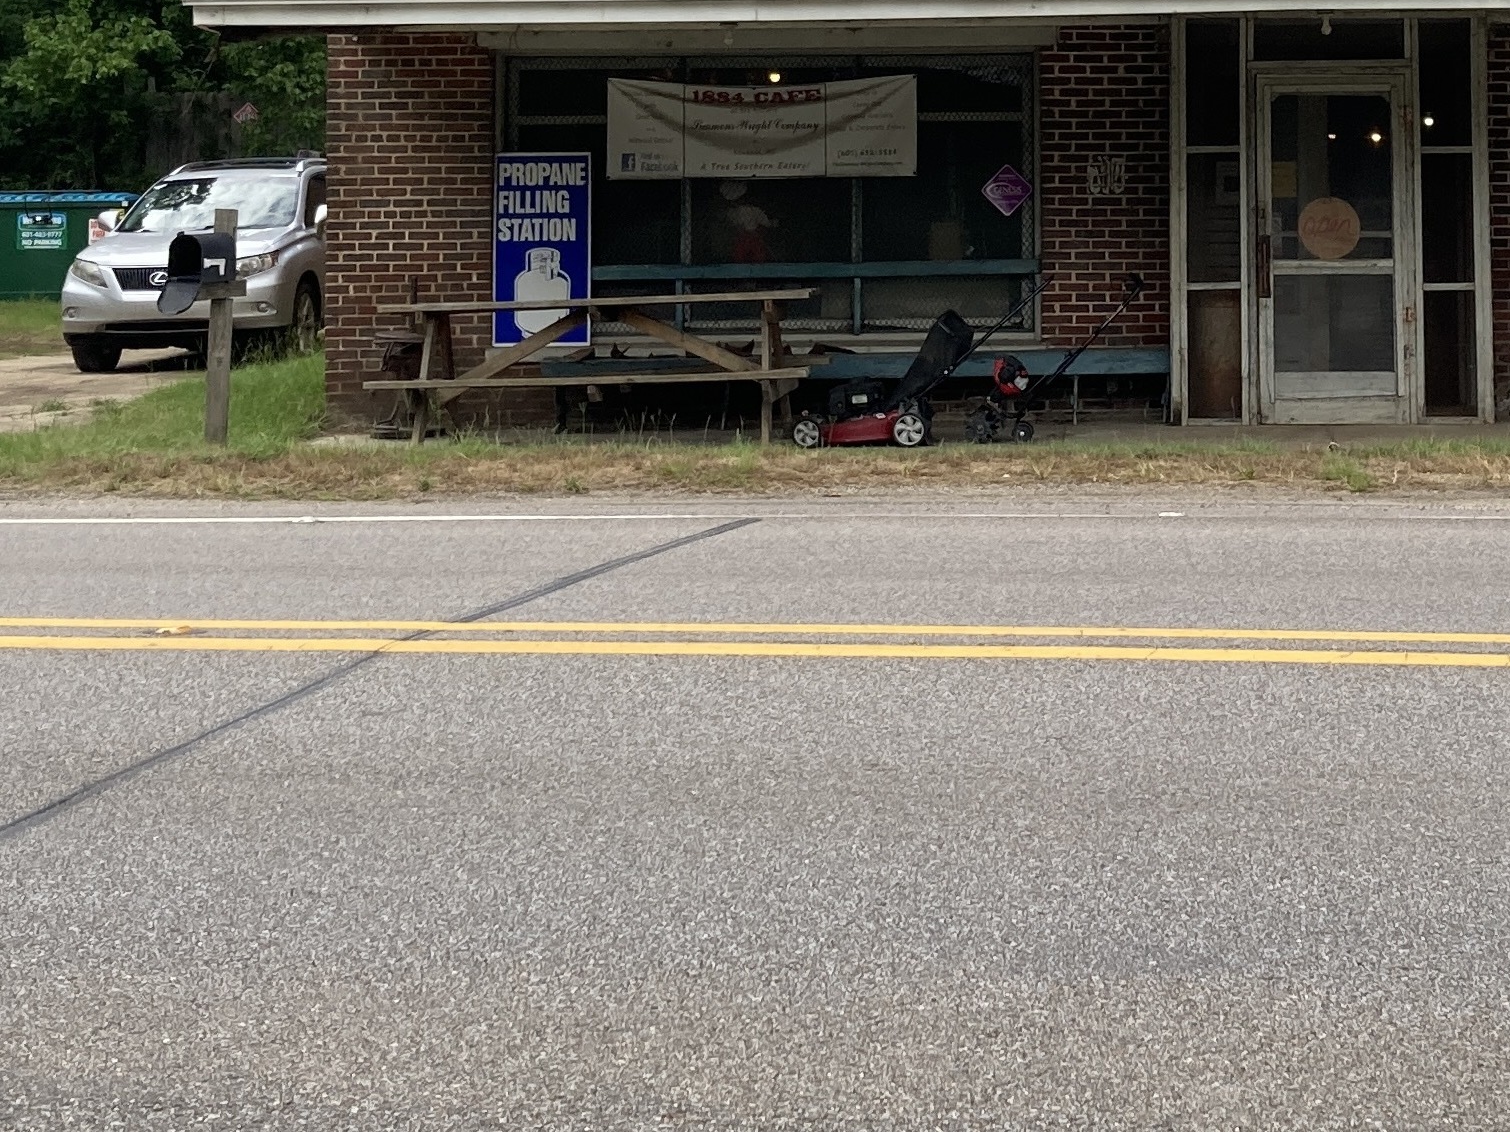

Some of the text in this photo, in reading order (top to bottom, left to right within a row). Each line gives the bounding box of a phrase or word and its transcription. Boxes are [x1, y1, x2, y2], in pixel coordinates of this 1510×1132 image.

[693, 89, 821, 104] 1884 CAFE
[774, 118, 819, 133] Company
[499, 162, 586, 186] PROPANE
[711, 162, 730, 170] True
[734, 162, 773, 170] Southern
[499, 190, 570, 214] FILLING
[498, 218, 576, 242] STATION
